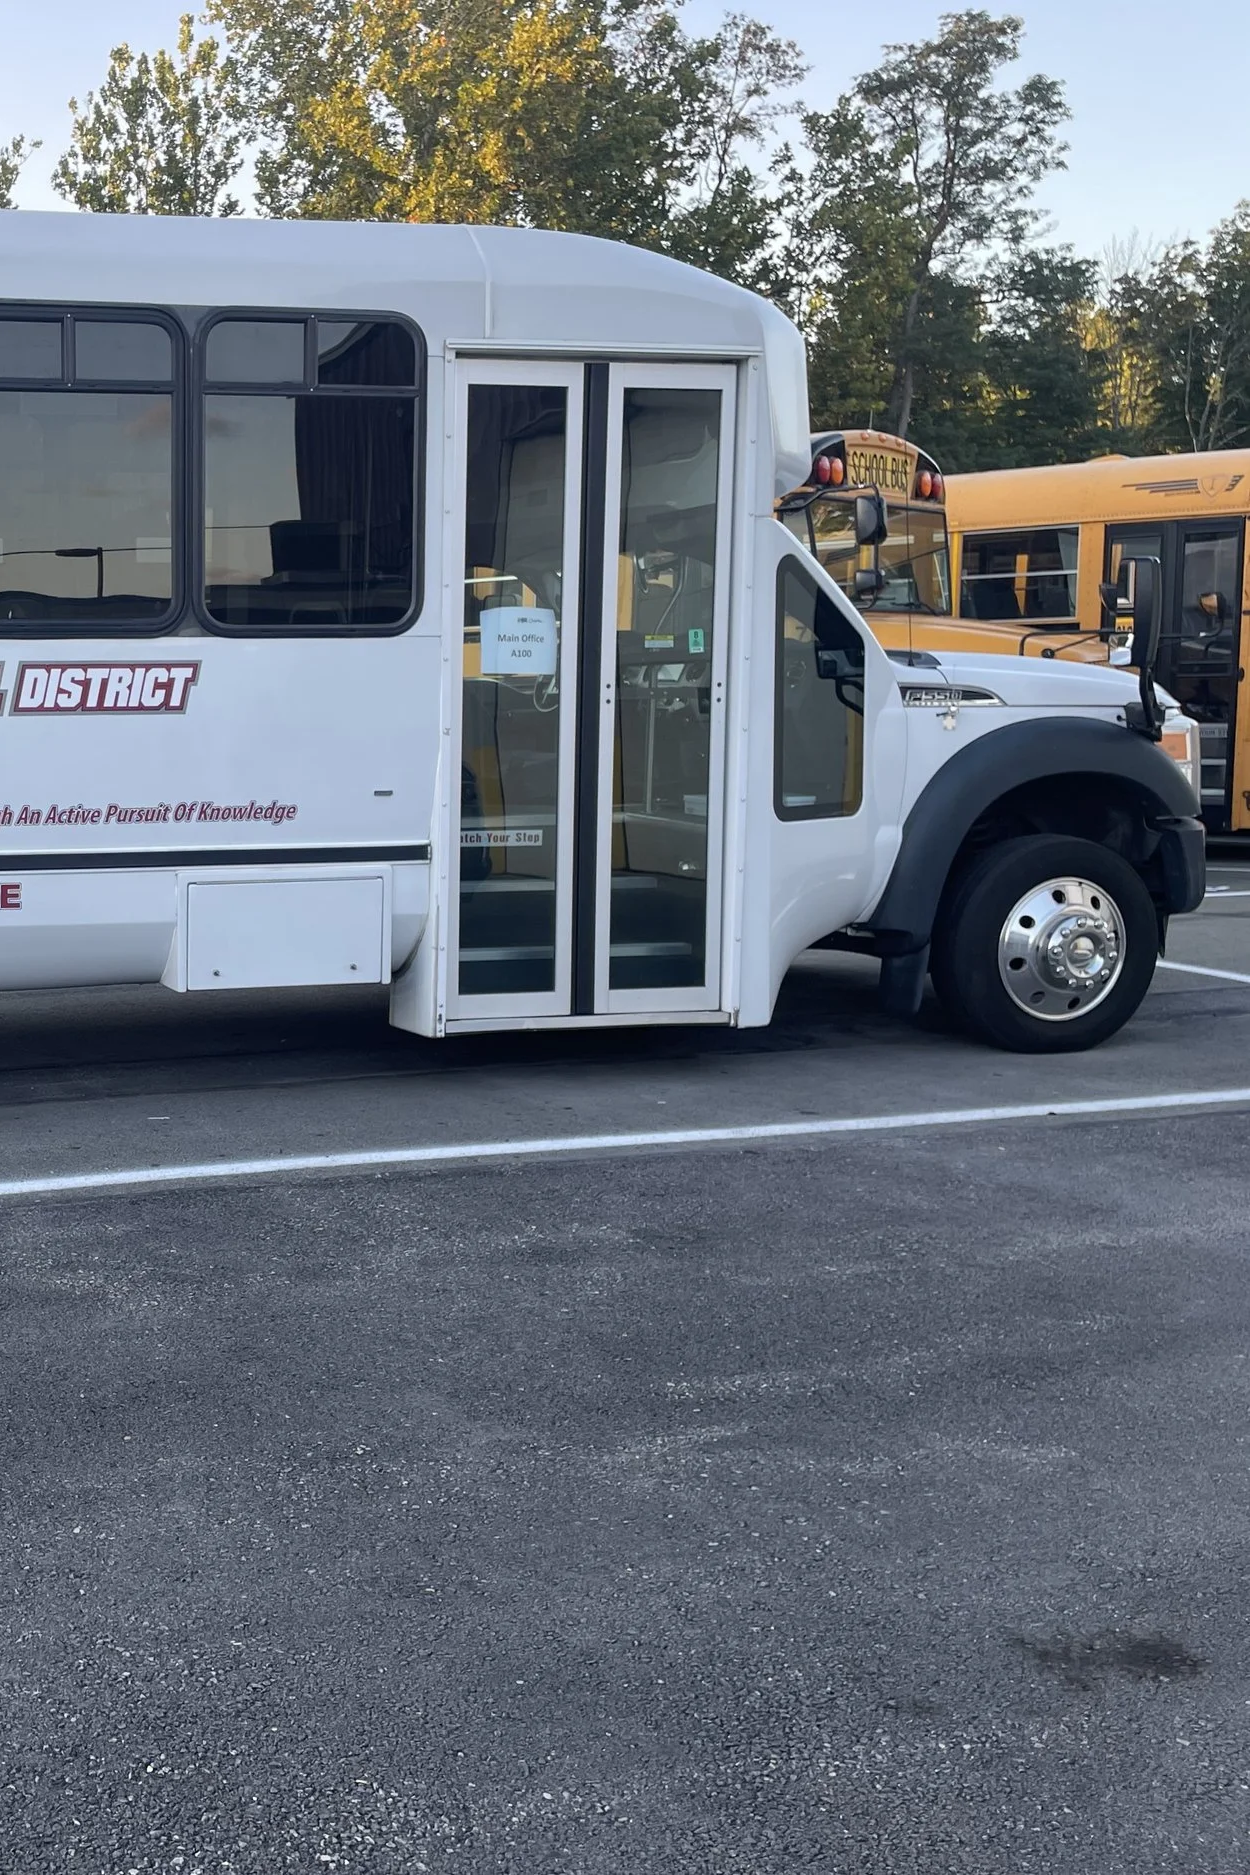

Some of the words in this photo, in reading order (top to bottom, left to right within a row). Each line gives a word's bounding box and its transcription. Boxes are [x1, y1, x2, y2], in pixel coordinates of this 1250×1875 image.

[851, 451, 889, 487] SCHOOL
[891, 457, 909, 491] BUS
[497, 634, 519, 642] Main
[521, 634, 544, 643] Office
[511, 649, 532, 658] A100
[18, 666, 196, 709] DISTRICT
[16, 804, 42, 826] An
[44, 804, 101, 825] Active
[103, 802, 172, 824] Pursuit
[174, 801, 196, 822] Of
[198, 800, 298, 825] Knowledge
[487, 832, 510, 842] Your
